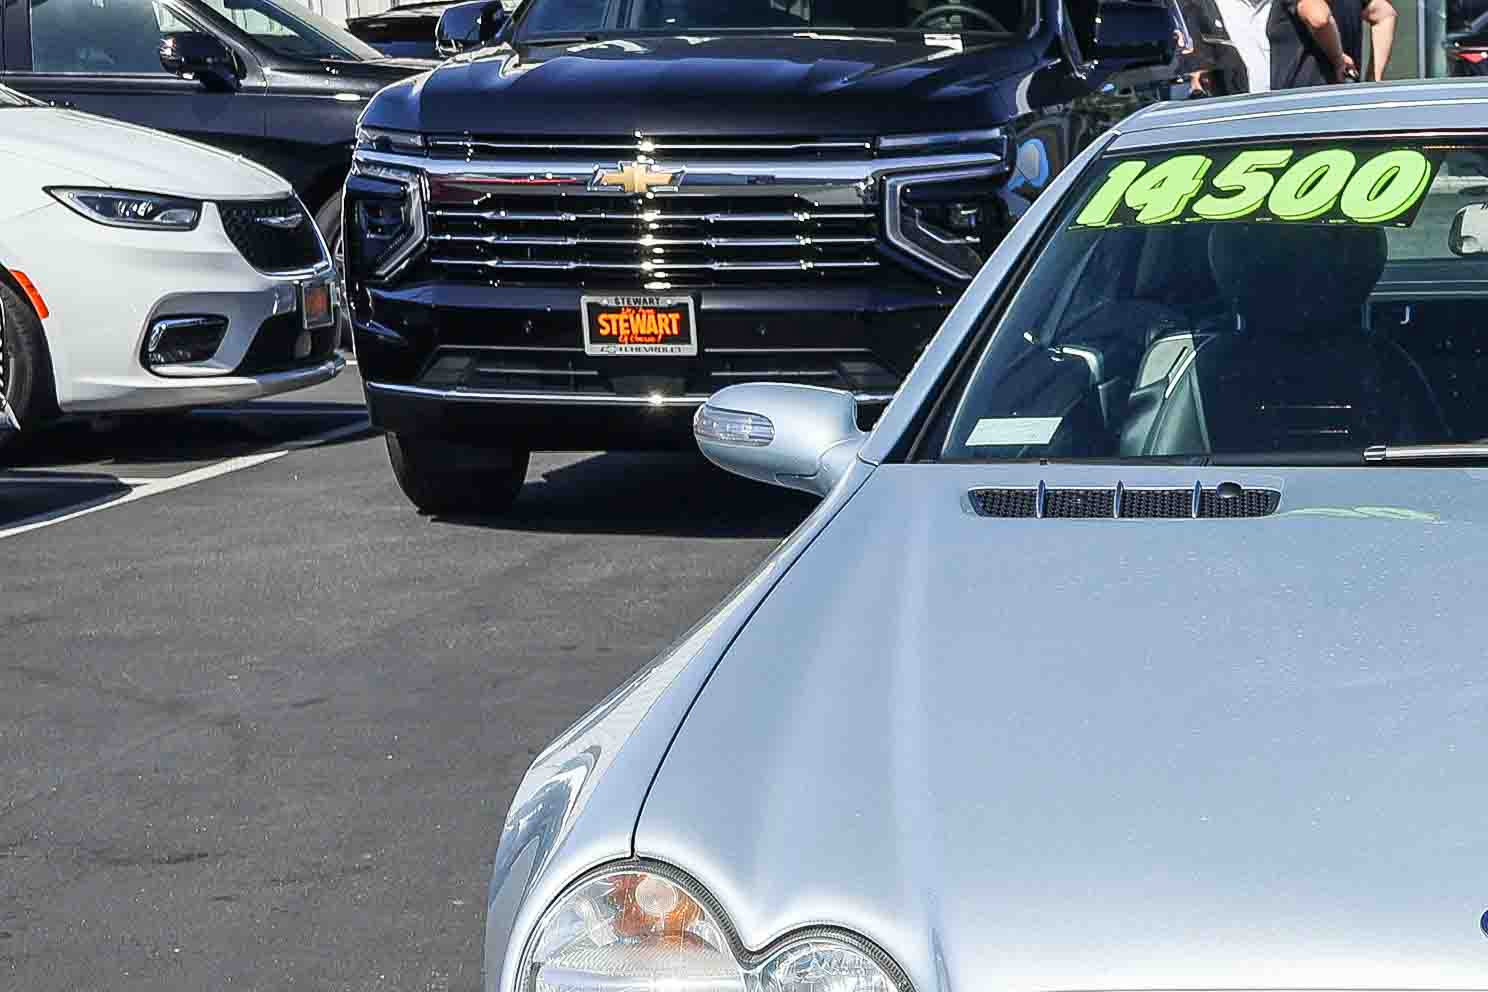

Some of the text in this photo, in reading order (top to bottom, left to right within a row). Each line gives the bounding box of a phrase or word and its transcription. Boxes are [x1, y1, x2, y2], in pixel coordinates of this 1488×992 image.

[1075, 149, 1431, 226] 14500
[614, 297, 660, 305] STEWART
[597, 313, 680, 335] STEWART
